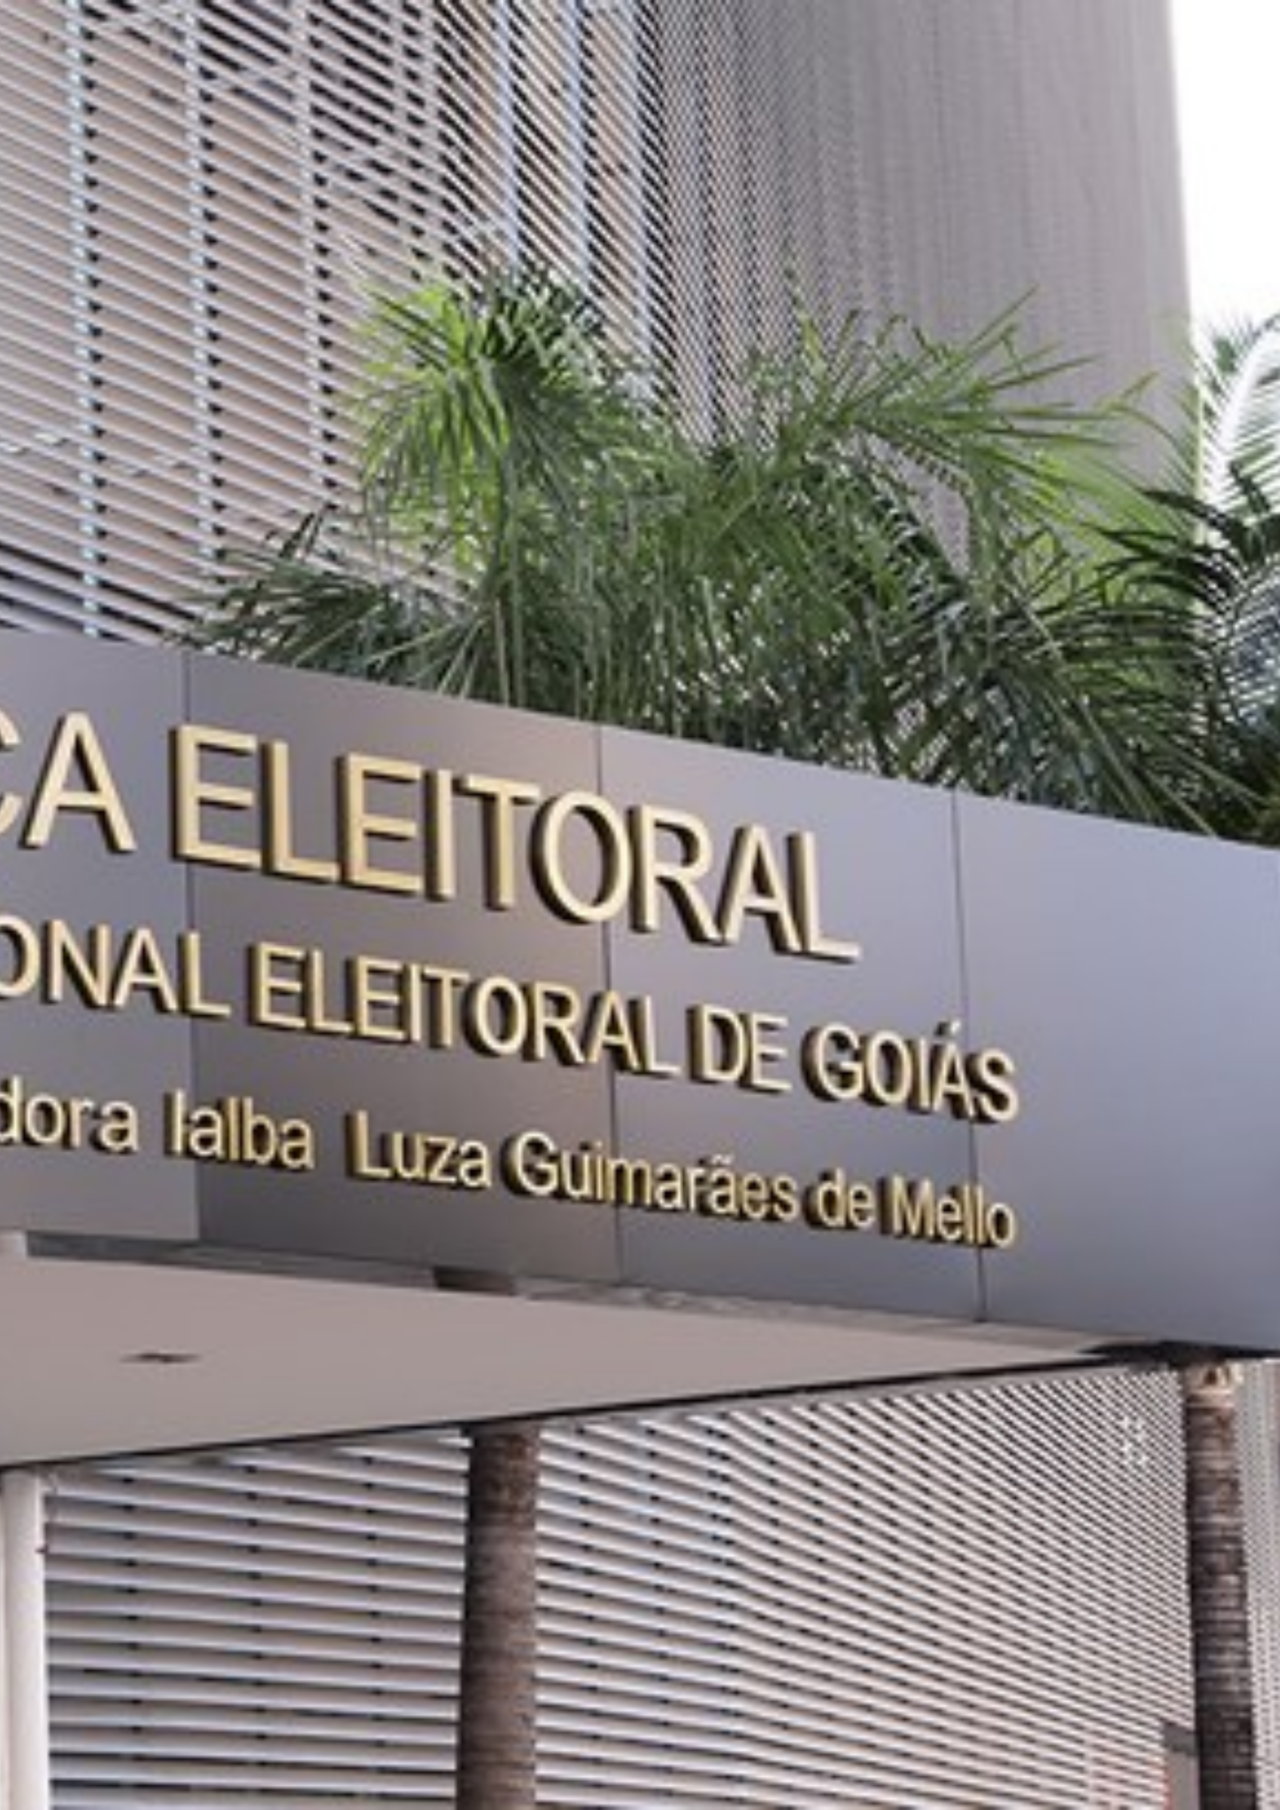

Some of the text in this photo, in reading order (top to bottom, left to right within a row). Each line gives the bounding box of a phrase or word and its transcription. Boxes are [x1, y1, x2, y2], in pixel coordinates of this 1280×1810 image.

[171, 723, 861, 962] ELEITORAL
[250, 940, 682, 1078] ELEITORAL
[688, 1002, 792, 1092] DE
[802, 1018, 1019, 1124] GOIÁS
[345, 1108, 493, 1191] Luza
[503, 1129, 802, 1224] Guimarães
[808, 1166, 877, 1231] de
[881, 1174, 1017, 1251] Mello
